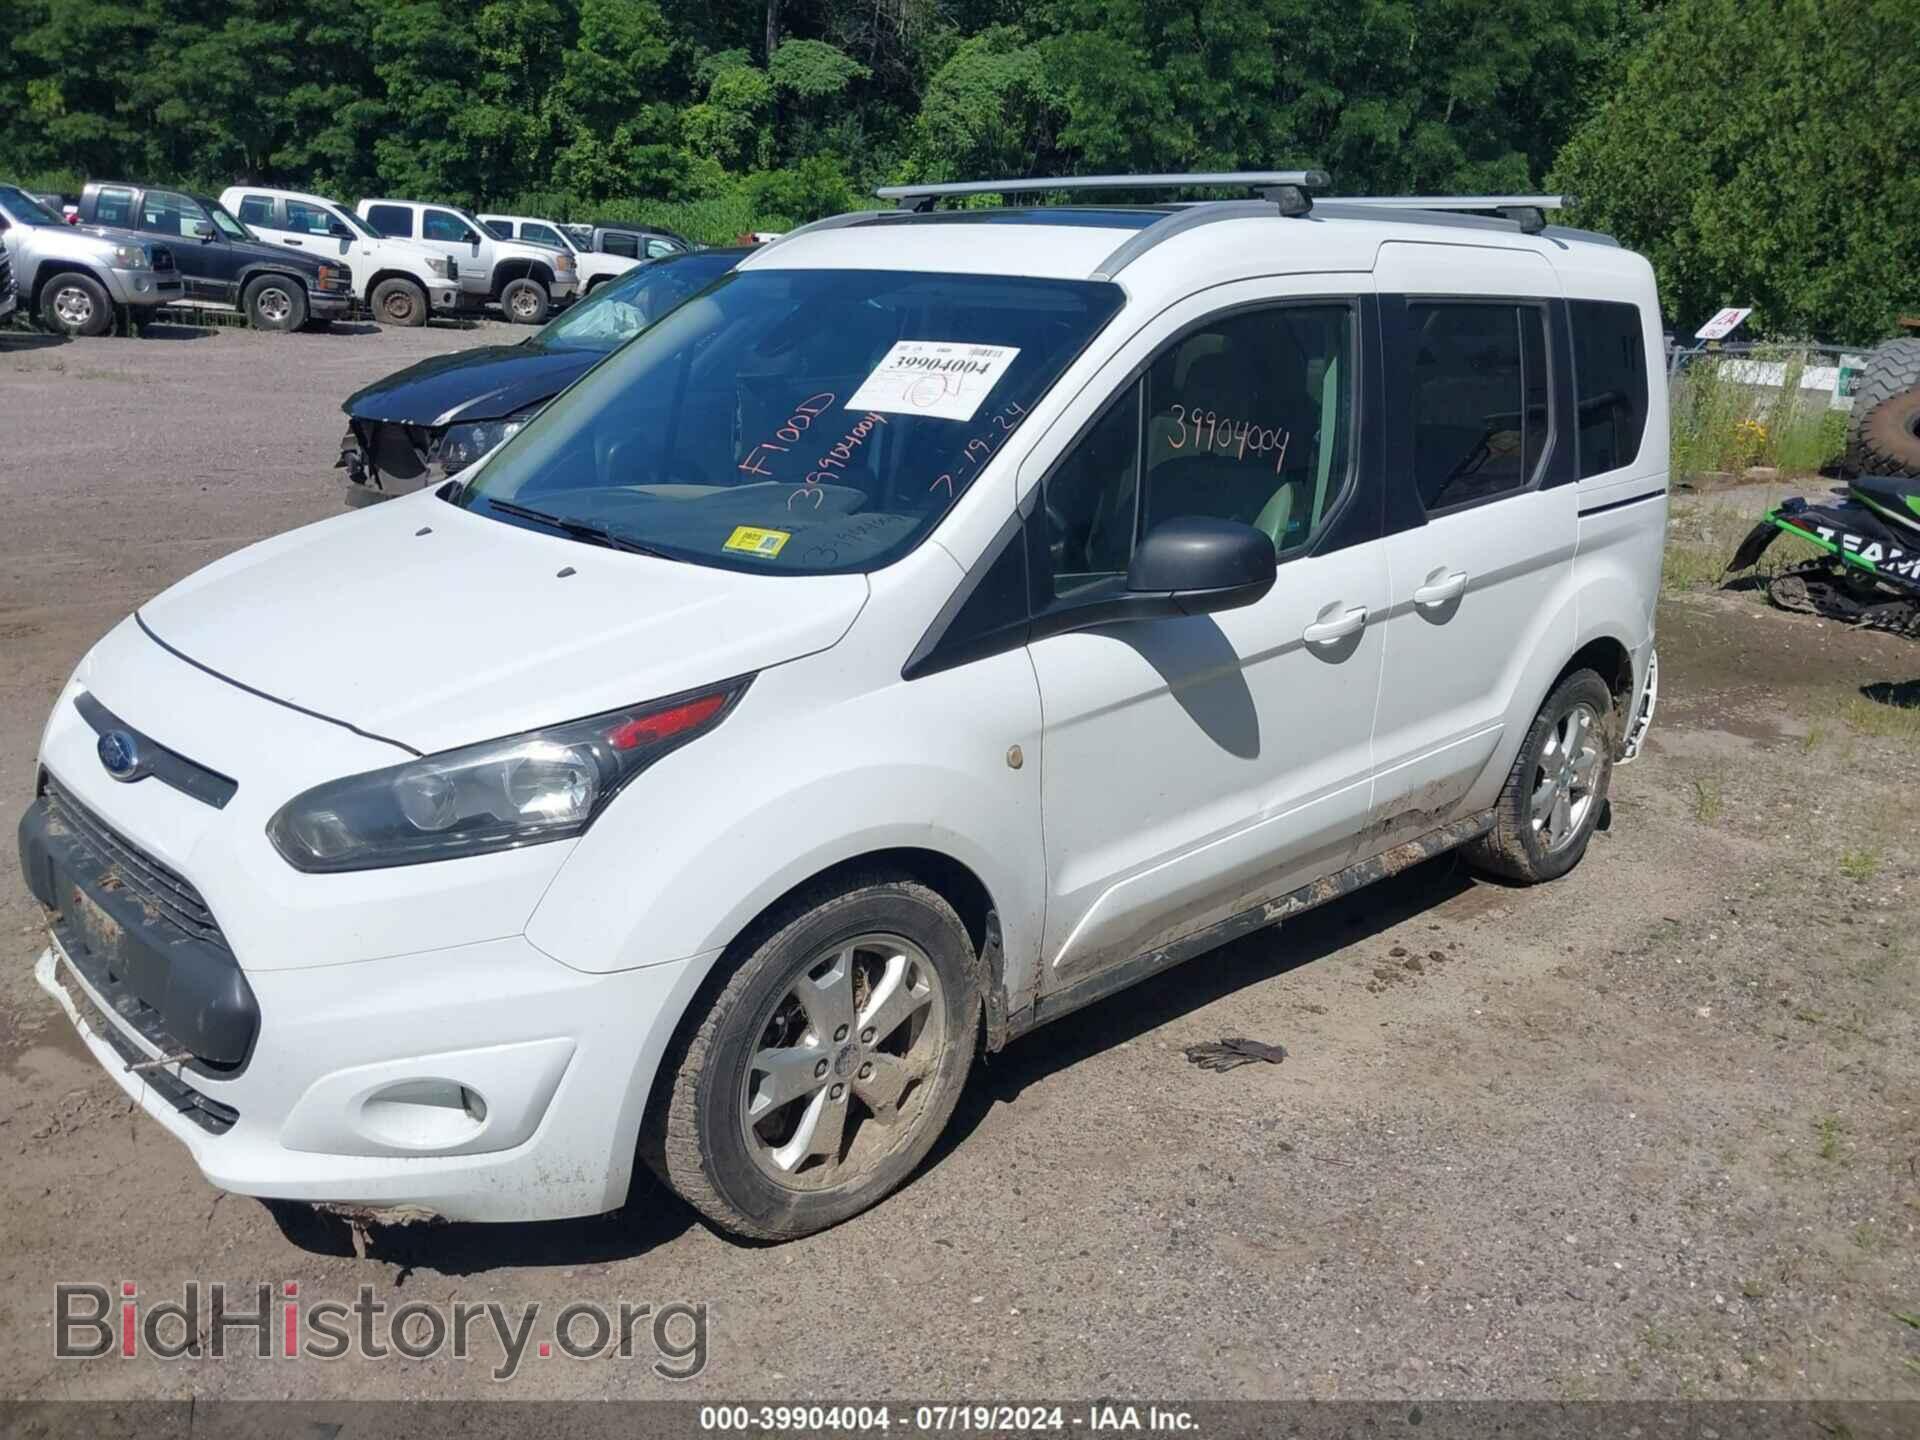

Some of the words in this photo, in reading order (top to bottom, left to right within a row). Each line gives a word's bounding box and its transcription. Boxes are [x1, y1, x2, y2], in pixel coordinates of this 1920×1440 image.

[888, 355, 992, 375] 39904004
[787, 411, 888, 511] 39904004
[1168, 404, 1290, 474] 39904004
